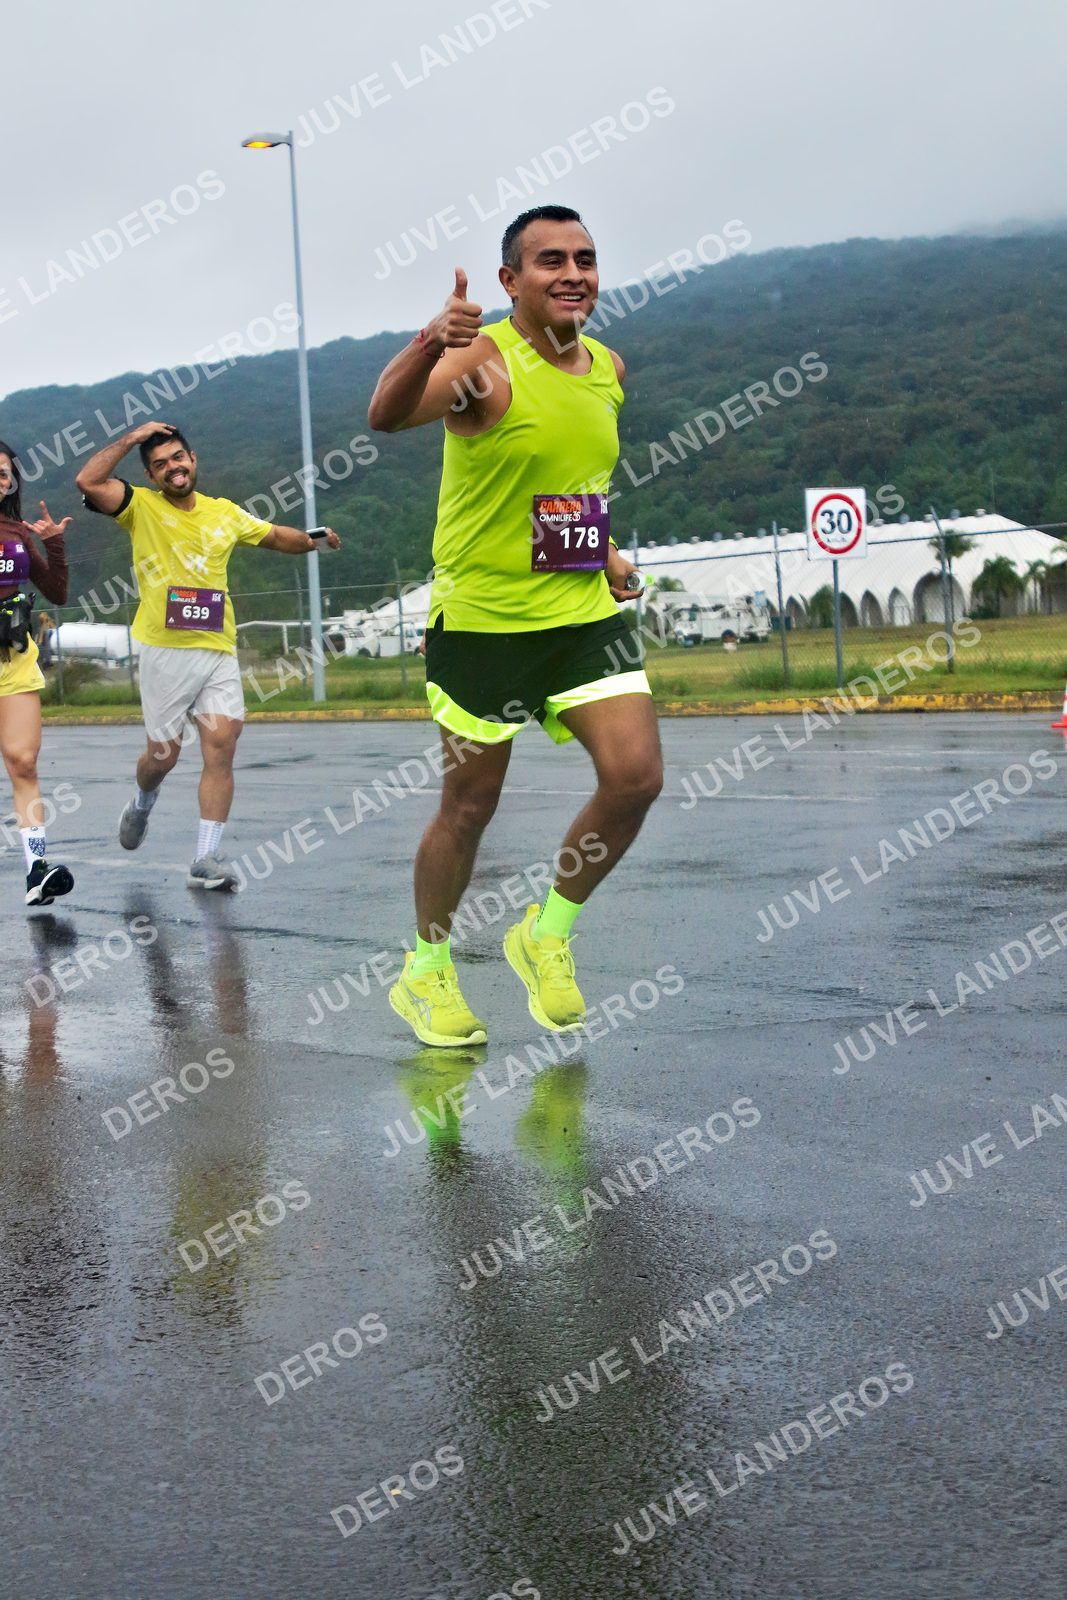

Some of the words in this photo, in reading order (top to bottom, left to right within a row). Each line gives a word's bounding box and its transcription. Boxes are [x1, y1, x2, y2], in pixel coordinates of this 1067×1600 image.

[821, 509, 853, 535] 30
[560, 526, 600, 549] 178
[182, 605, 210, 620] 639
